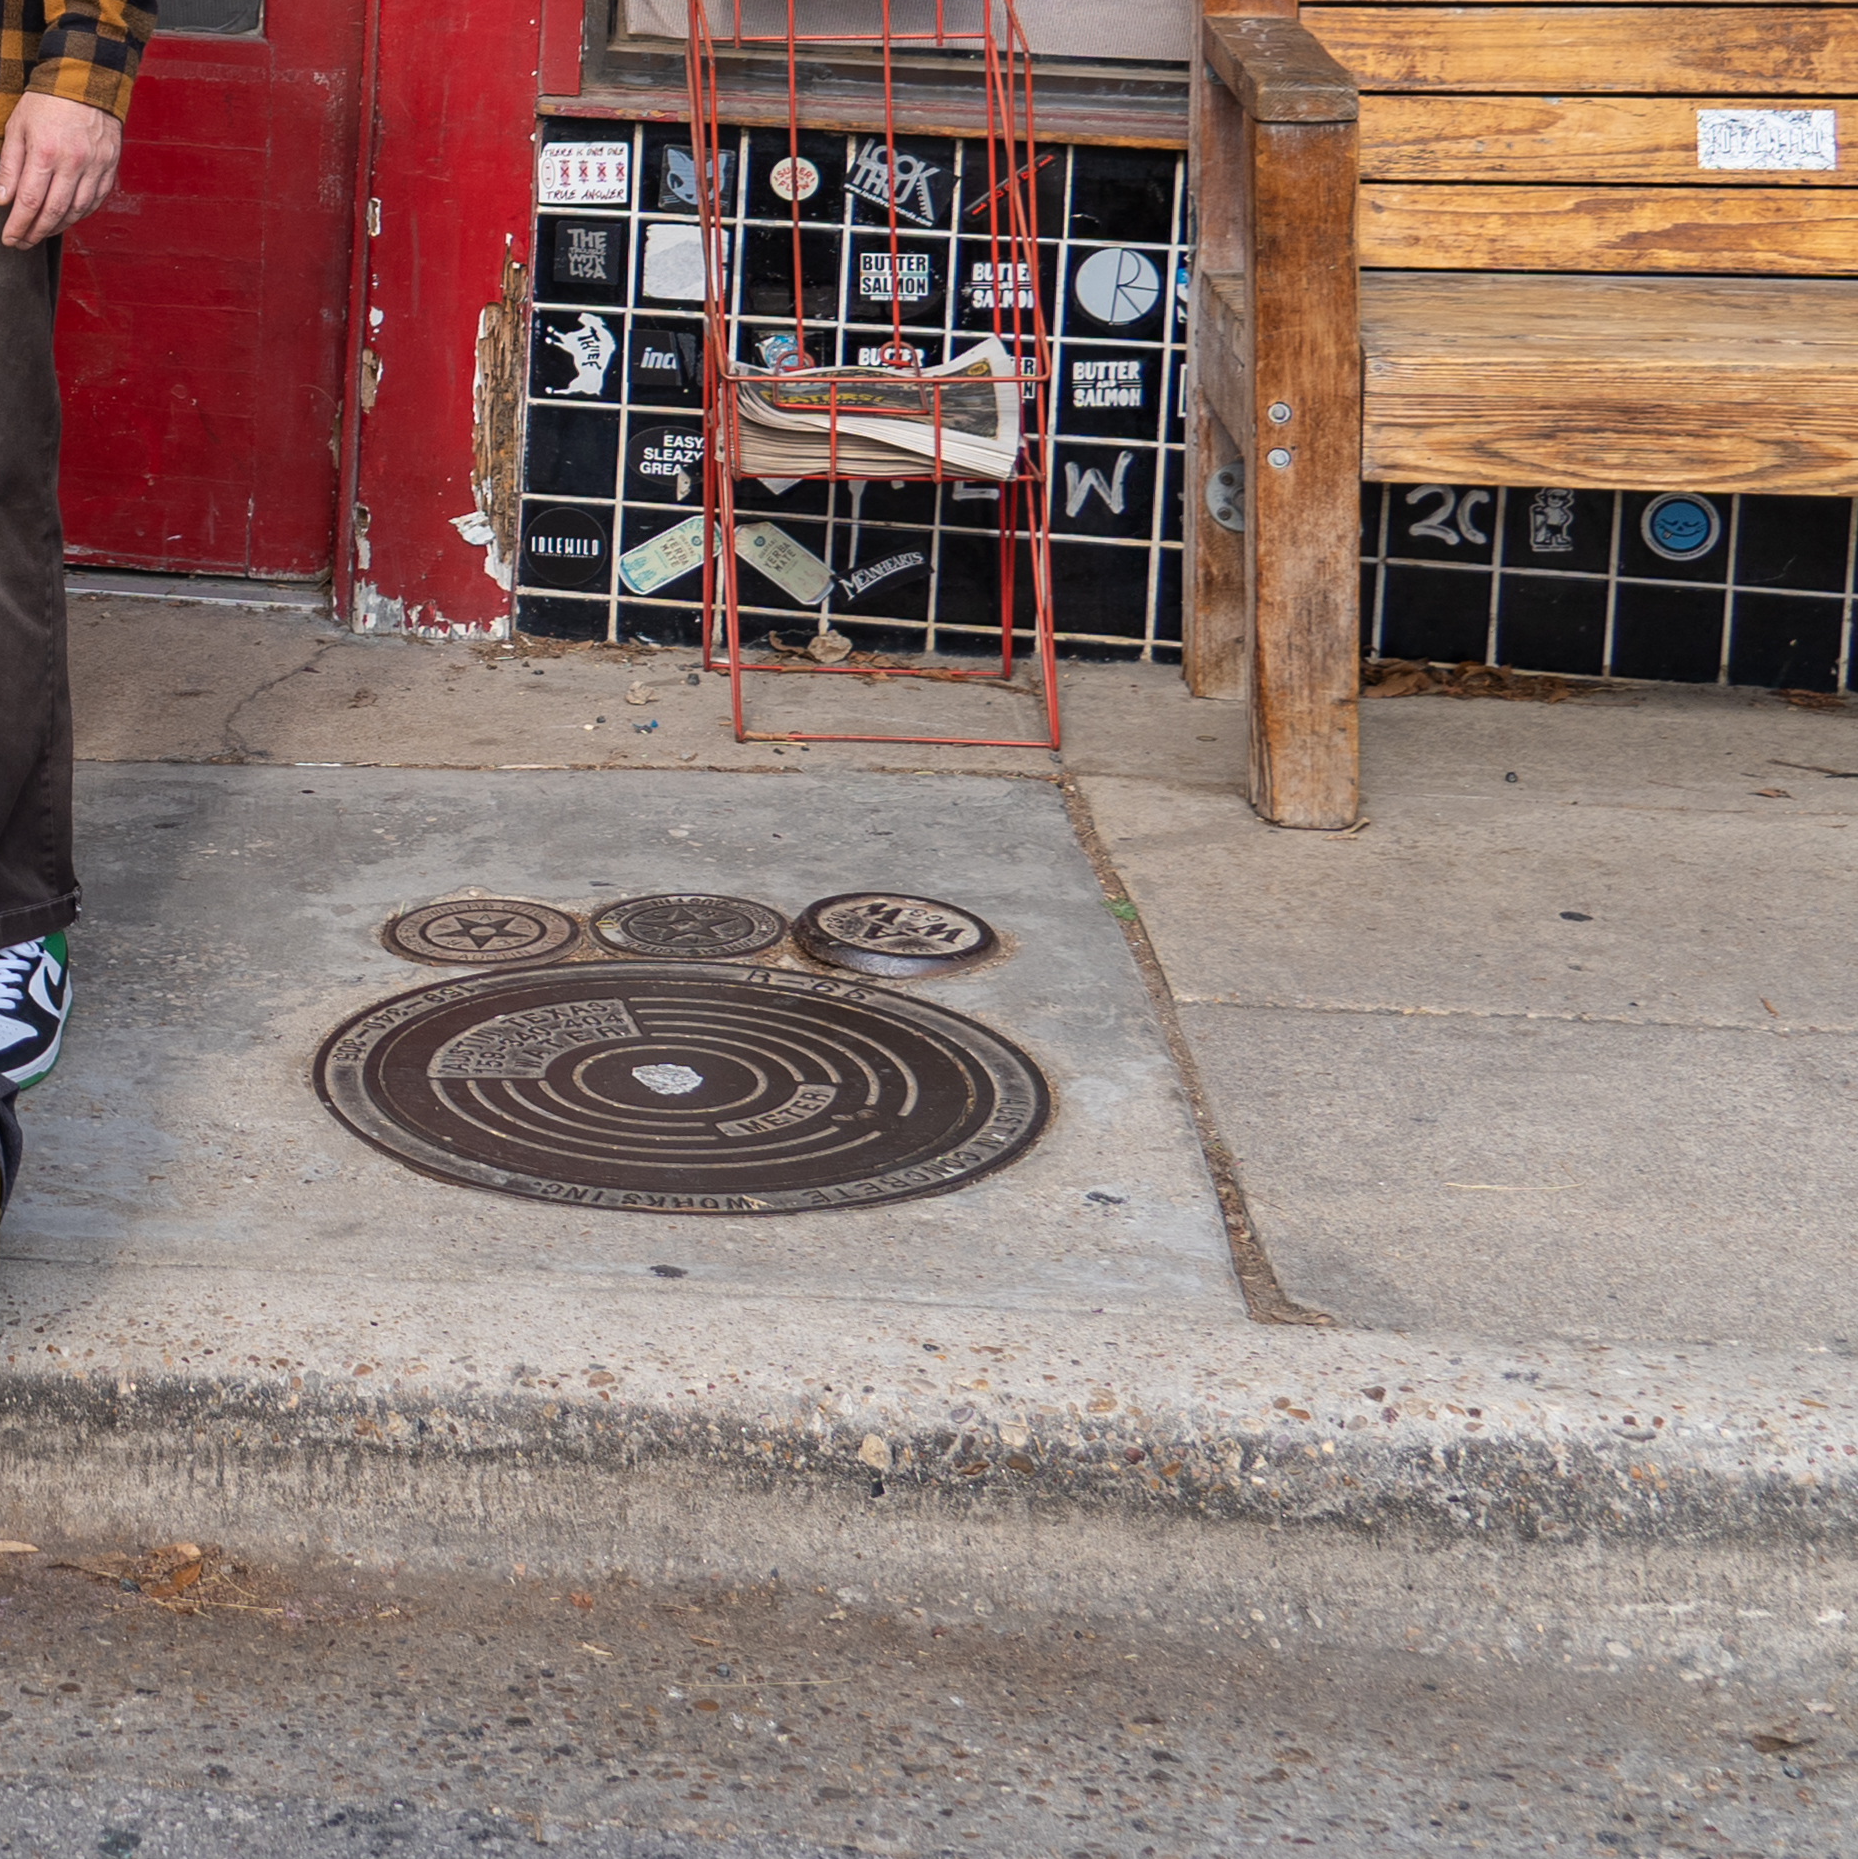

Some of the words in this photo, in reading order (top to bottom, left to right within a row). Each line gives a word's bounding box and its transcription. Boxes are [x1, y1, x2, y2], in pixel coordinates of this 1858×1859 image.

[545, 145, 574, 158] THERE
[546, 190, 576, 200] TRUE
[581, 188, 625, 201] ANSWER
[566, 228, 608, 250] THE
[568, 253, 607, 267] WITH
[862, 255, 928, 272] BUTTER
[971, 262, 1033, 282] BUTTE
[861, 277, 928, 295] SALMON
[1072, 361, 1142, 380] BUTTER
[1072, 389, 1143, 408] SALMON
[643, 447, 704, 463] SLEAZY
[531, 536, 600, 556] IDLEWILD
[666, 536, 690, 566] YERBA
[763, 541, 791, 569] YERBA
[659, 544, 681, 569] MATE
[773, 549, 797, 572] MATE
[743, 1091, 831, 1134] METER
